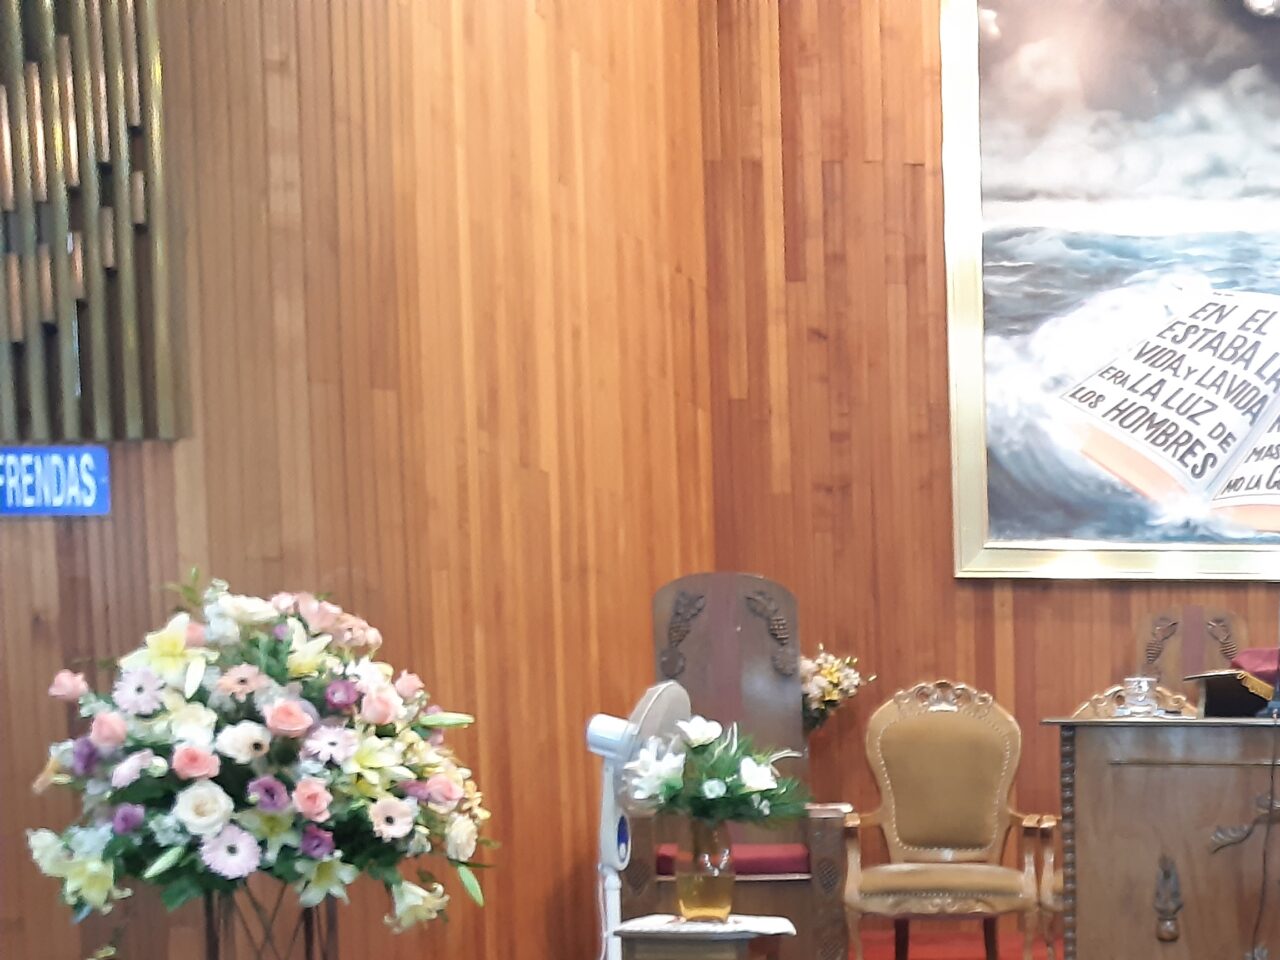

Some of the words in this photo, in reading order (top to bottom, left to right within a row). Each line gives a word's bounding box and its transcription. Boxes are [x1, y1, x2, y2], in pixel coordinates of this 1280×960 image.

[1189, 302, 1238, 324] EN
[1238, 309, 1278, 335] EL
[1133, 341, 1186, 378] VIDA
[1156, 320, 1261, 370] ESTABA
[1098, 366, 1131, 387] ERA
[1127, 373, 1167, 402] LA
[1161, 388, 1218, 426] LUZ
[1208, 422, 1237, 453] DE
[1069, 386, 1105, 409] LOS
[1102, 398, 1217, 479] HOMBRES
[1221, 477, 1245, 495] NO
[1245, 475, 1263, 490] LA
